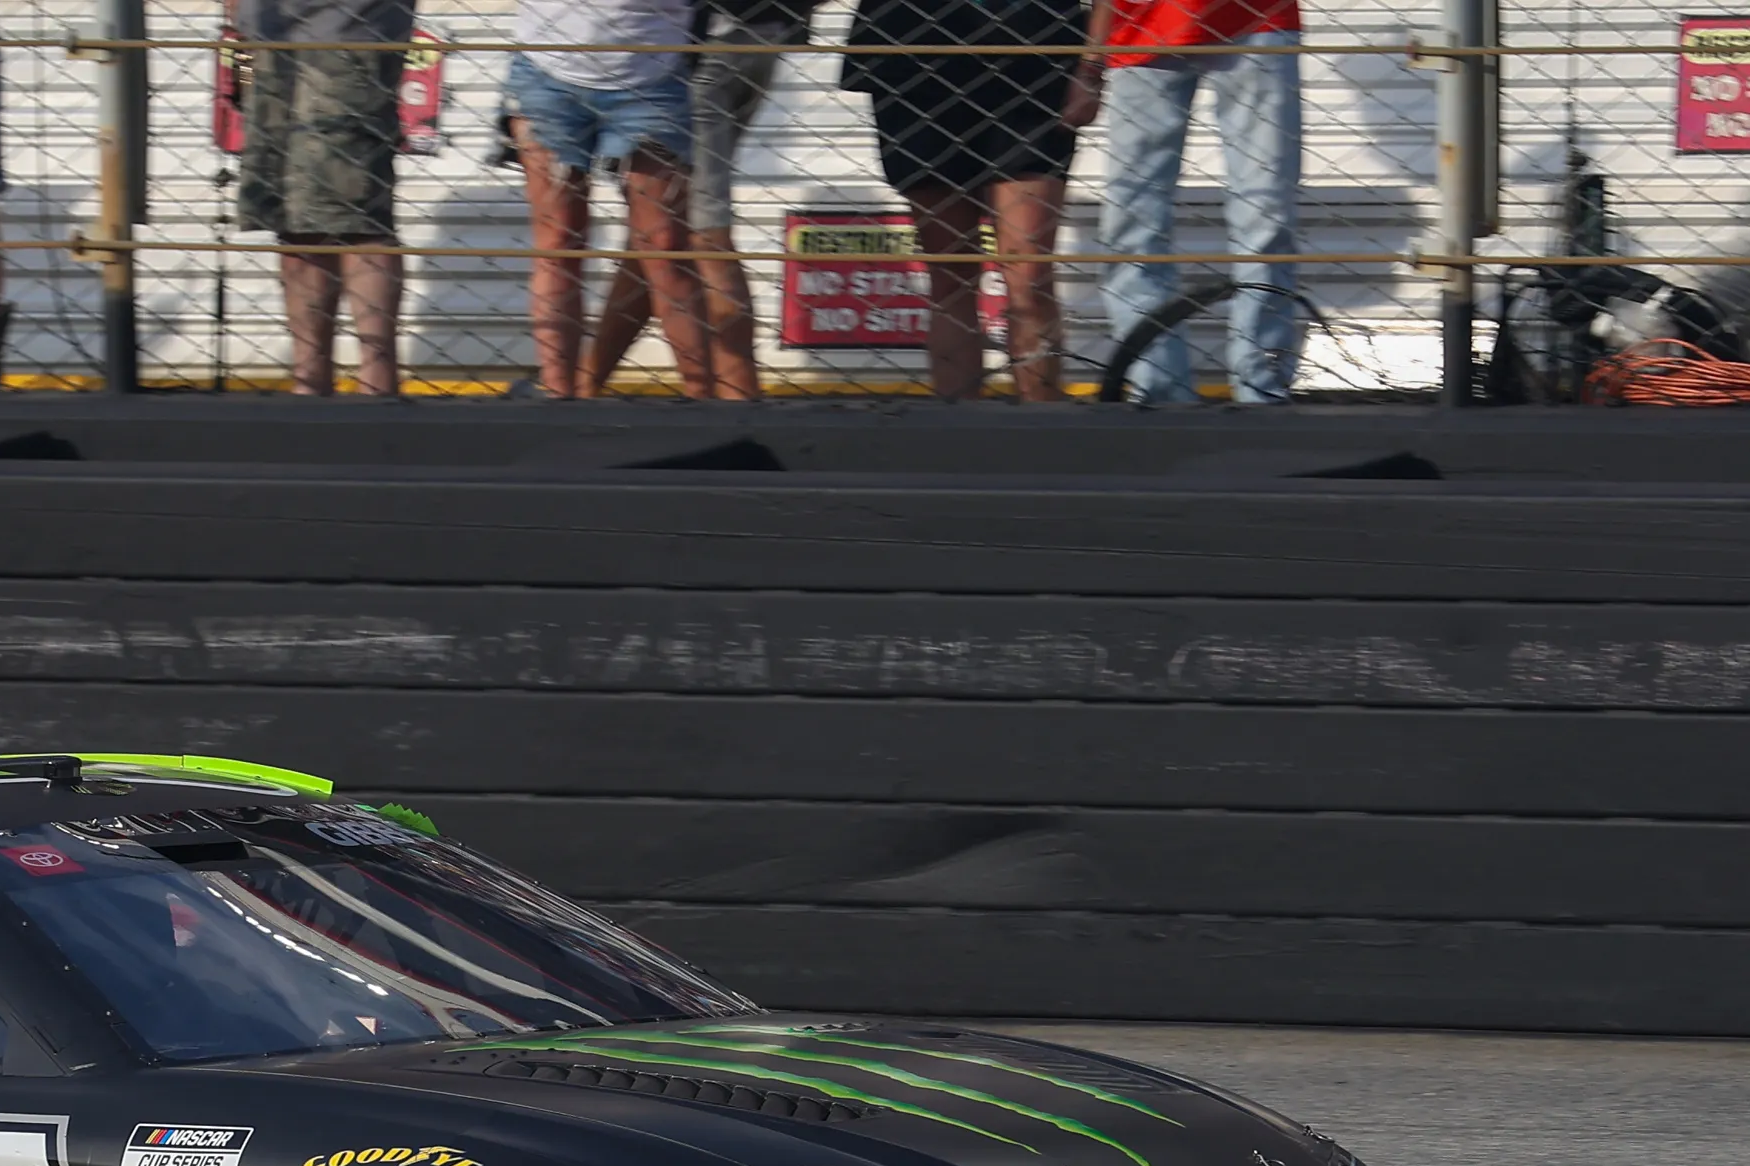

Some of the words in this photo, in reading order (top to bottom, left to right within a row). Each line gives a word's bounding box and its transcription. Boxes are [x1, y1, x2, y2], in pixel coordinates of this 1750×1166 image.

[796, 271, 845, 295] NO
[811, 307, 859, 331] NO
[164, 1129, 234, 1146] NASCAR
